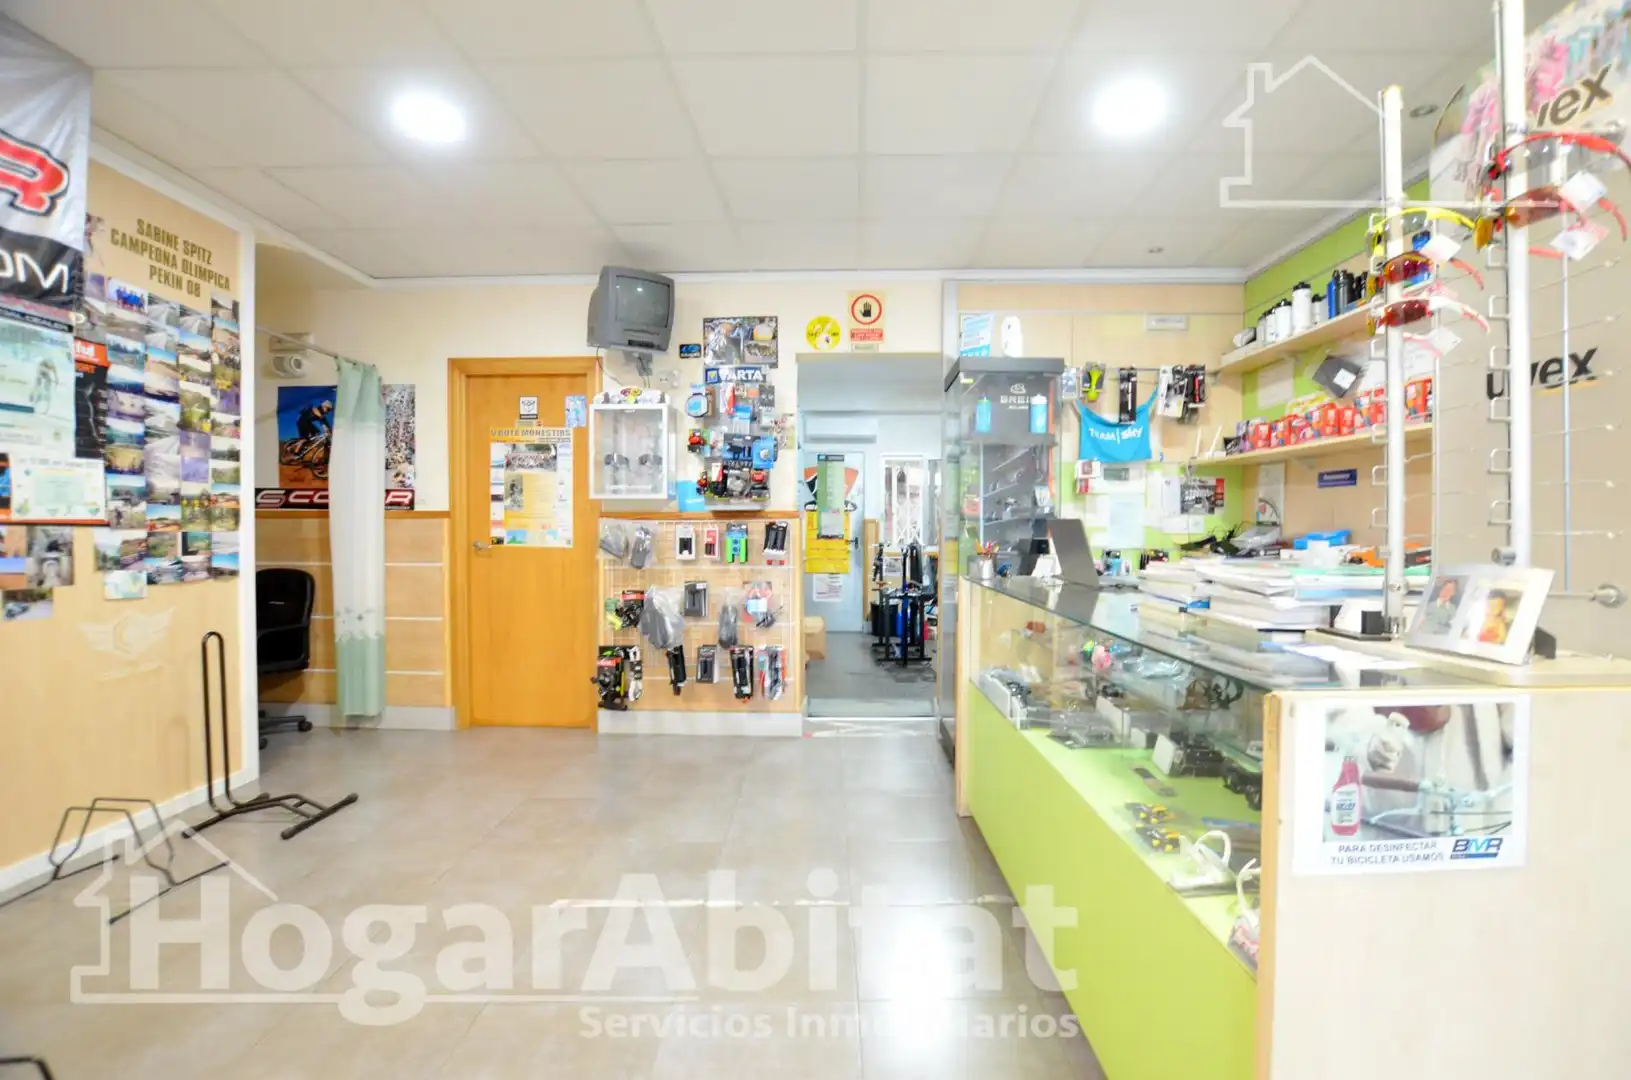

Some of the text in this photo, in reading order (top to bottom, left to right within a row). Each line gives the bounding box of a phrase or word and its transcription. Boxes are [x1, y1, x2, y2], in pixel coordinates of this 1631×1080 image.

[136, 218, 213, 266] SABINE SPITZ
[110, 228, 231, 291] CAMPEONA OLIMPICA
[149, 264, 202, 297] PEKIN 08
[1330, 856, 1344, 865] TU
[1347, 853, 1399, 865] BICICLETA
[1402, 851, 1444, 864] USAMOS
[1338, 841, 1437, 854] PARA DESINFECTAR
